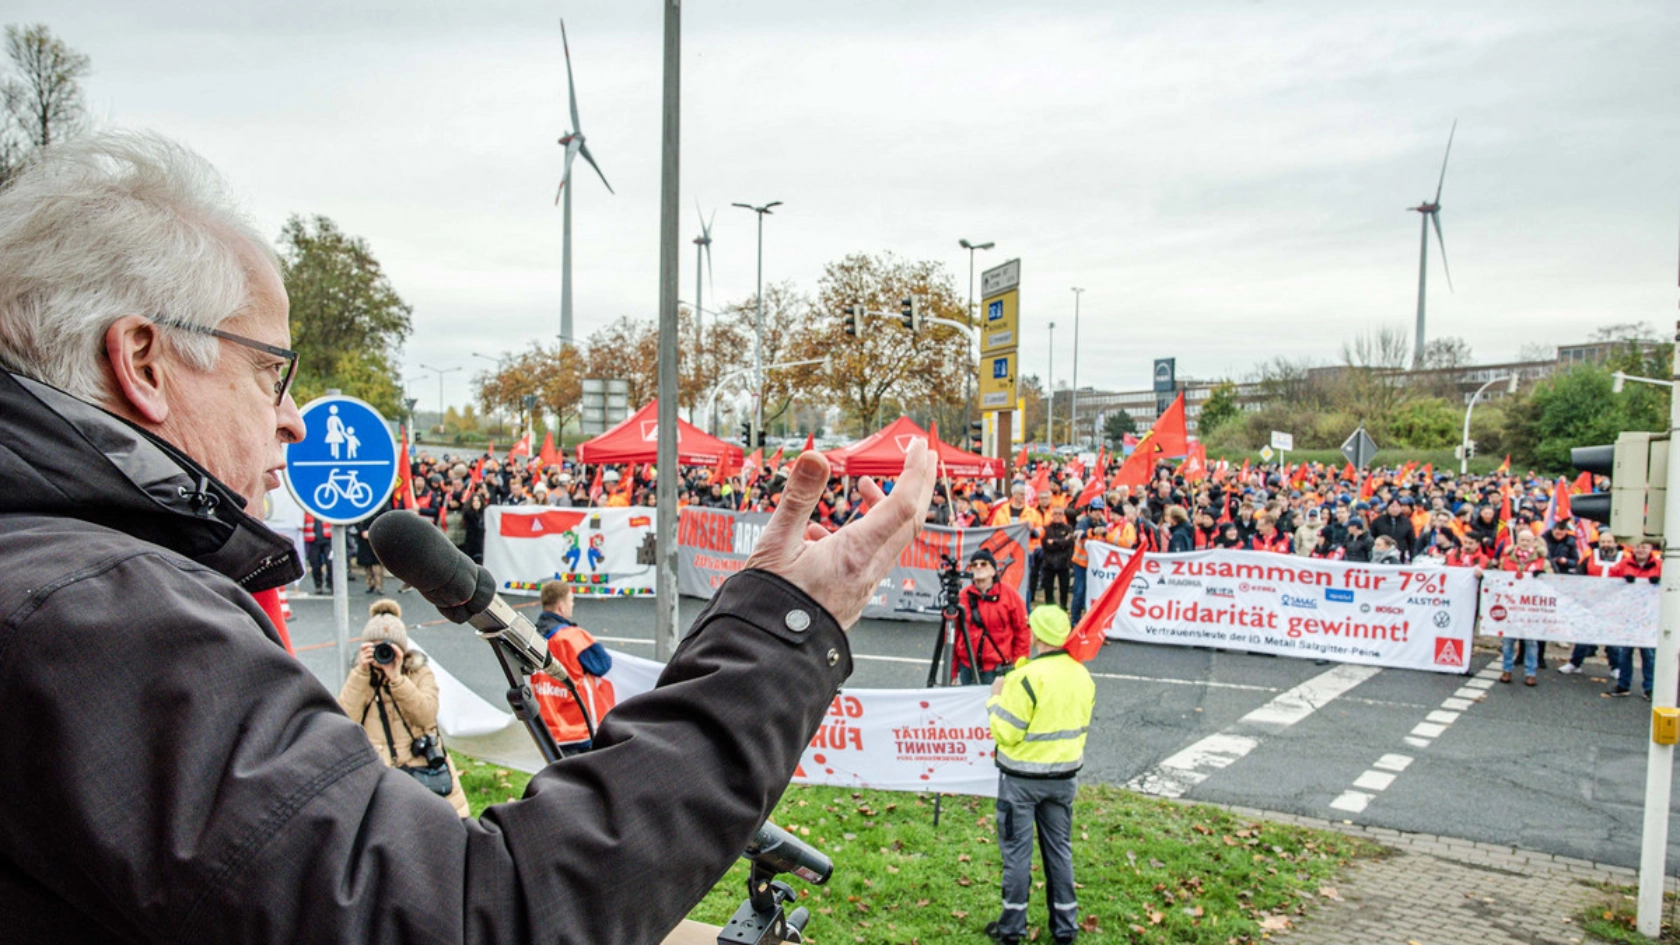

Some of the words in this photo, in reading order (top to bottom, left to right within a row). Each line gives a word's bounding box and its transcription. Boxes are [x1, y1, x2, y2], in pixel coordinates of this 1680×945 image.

[677, 508, 735, 554] UNSERE
[735, 521, 767, 555] ARB
[1091, 568, 1116, 579] VOIT
[1103, 550, 1160, 574] Ae
[1171, 560, 1332, 587] zusammen
[1343, 568, 1387, 590] für
[1398, 570, 1447, 594] 7%!
[1375, 605, 1404, 614] BOSCH
[1407, 597, 1450, 607] ALSTOM
[1519, 595, 1557, 607] MEHR
[1129, 596, 1278, 629] Solidarität
[1287, 616, 1410, 642] gewinnt!
[1145, 626, 1227, 640] Vertrauensleute
[1229, 631, 1246, 642] der
[1264, 636, 1296, 649] Metall
[1299, 640, 1381, 658] Salzgitter-Peine
